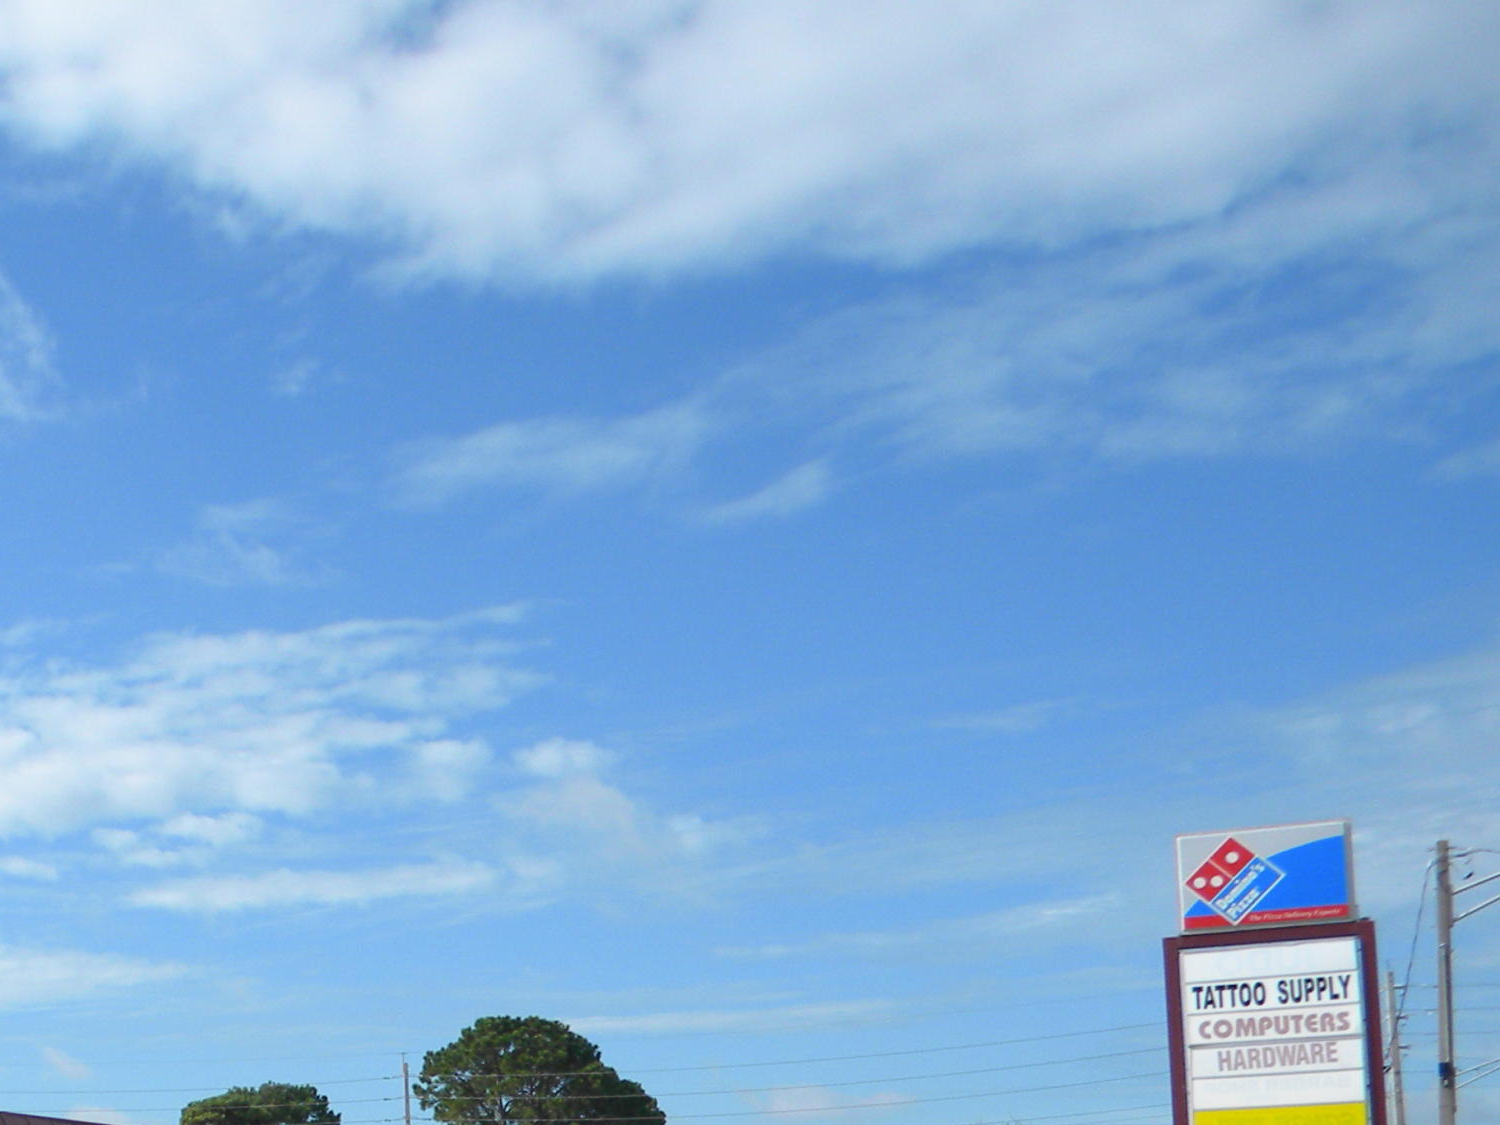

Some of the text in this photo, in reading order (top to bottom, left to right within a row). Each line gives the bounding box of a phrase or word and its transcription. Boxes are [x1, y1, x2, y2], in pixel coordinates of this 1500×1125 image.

[1215, 864, 1265, 910] Domino's
[1226, 888, 1261, 920] Pizza
[1192, 975, 1352, 1010] TATTOO SUPPLY
[1198, 1011, 1350, 1040] COMPUTERS
[1217, 1042, 1338, 1072] HARDWARE
